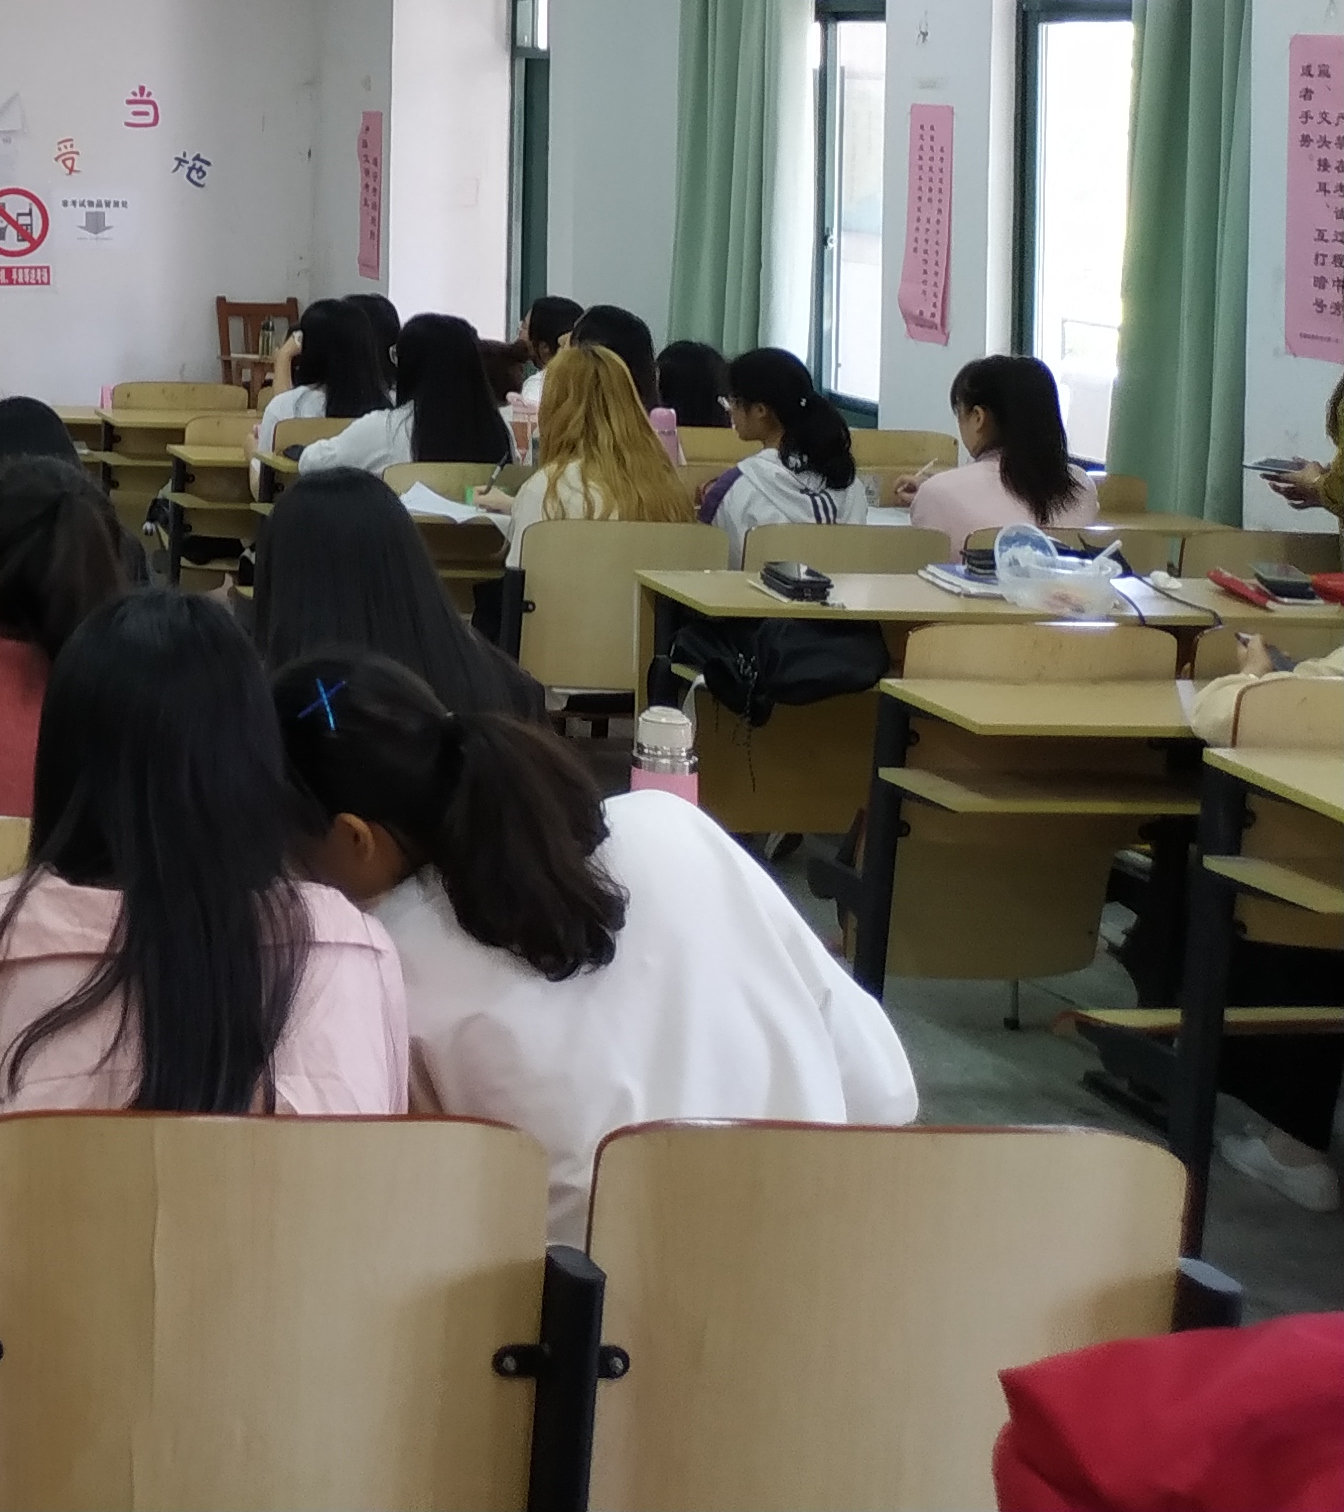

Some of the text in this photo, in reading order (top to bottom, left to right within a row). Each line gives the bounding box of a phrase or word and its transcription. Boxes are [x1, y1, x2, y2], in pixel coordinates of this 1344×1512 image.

[124, 85, 160, 128] 当
[54, 138, 81, 176] 受
[172, 151, 212, 188] 施
